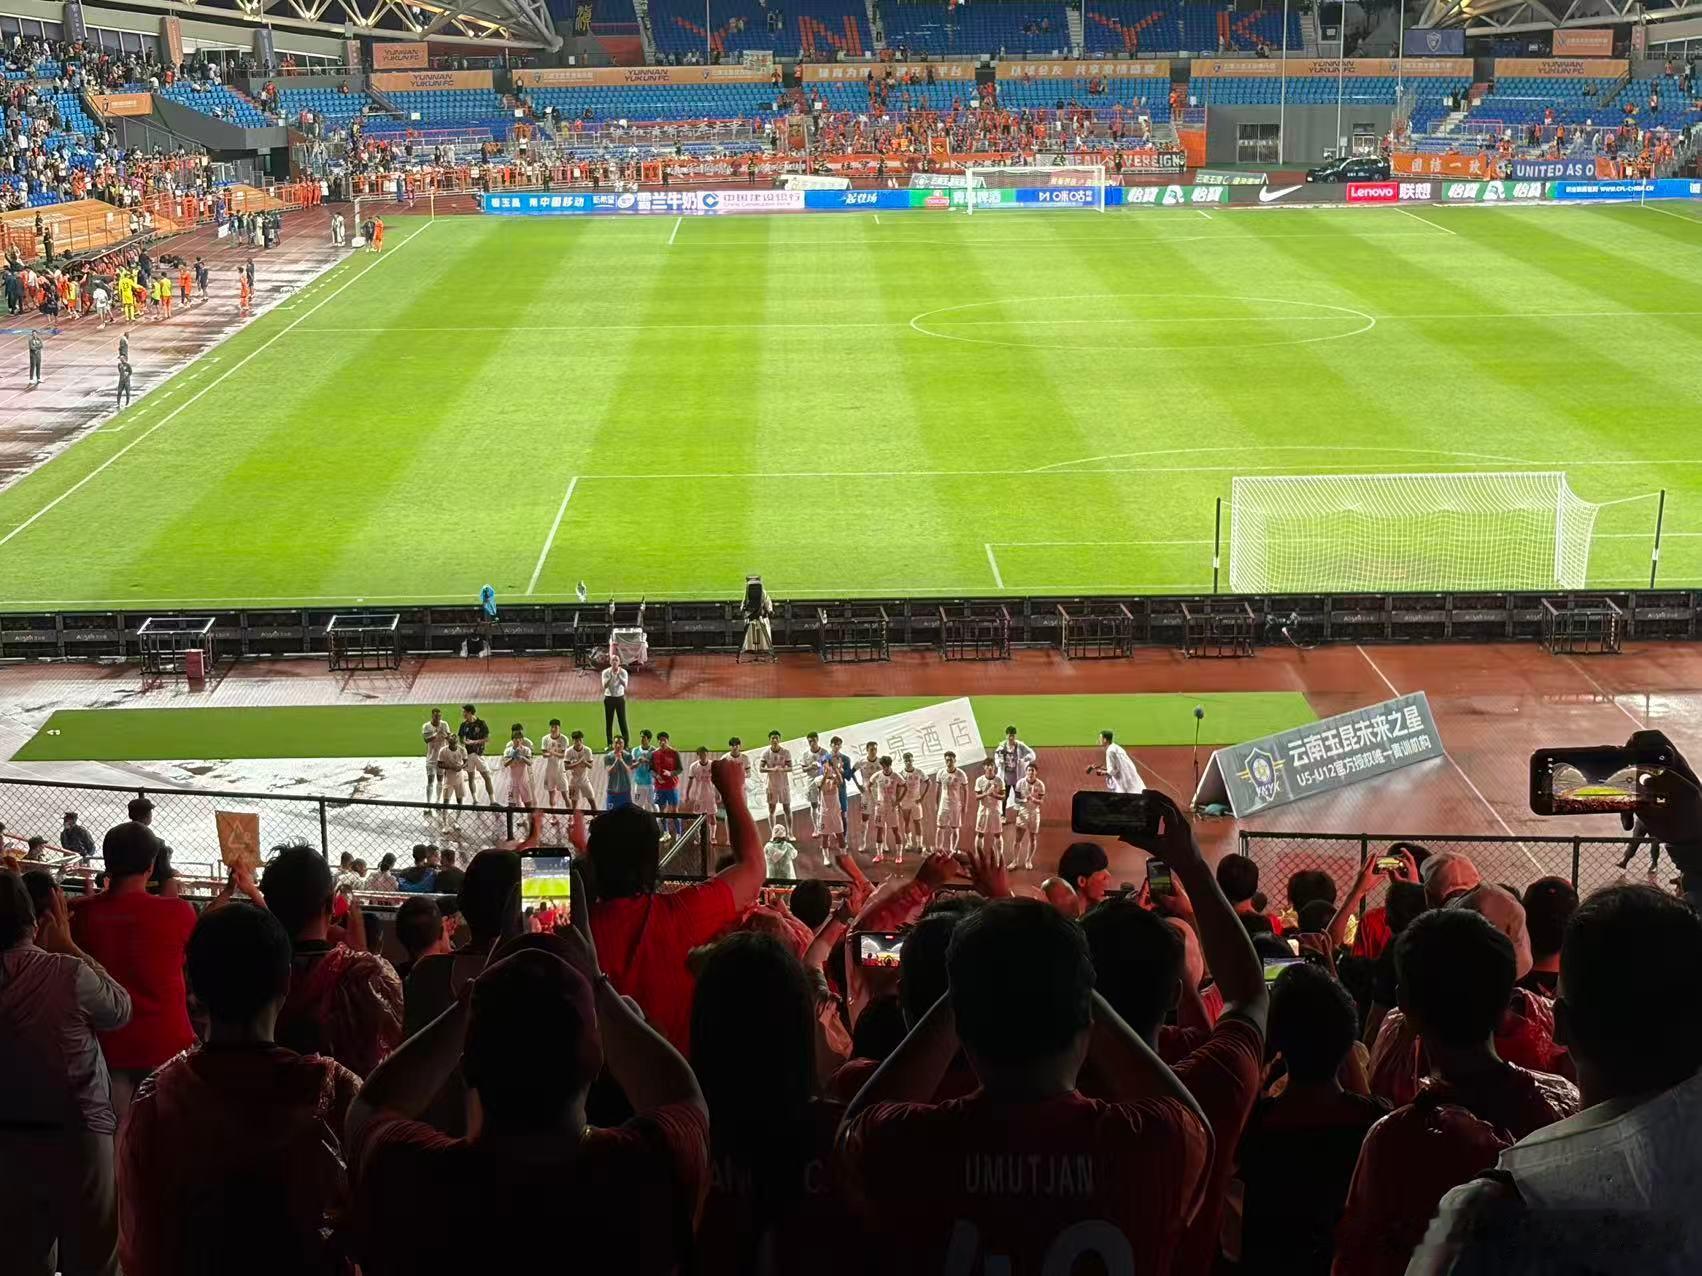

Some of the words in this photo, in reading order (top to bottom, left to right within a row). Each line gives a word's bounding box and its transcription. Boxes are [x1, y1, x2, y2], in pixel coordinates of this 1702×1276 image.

[1107, 154, 1180, 168] SVEREIGN
[1516, 164, 1564, 177] UNITED
[1566, 164, 1583, 176] AS
[1351, 186, 1393, 197] Lenovo
[1399, 183, 1431, 199] 联想
[1287, 704, 1425, 768] 云南玉昆未来之星
[964, 1153, 1095, 1196] UMUTJAN
